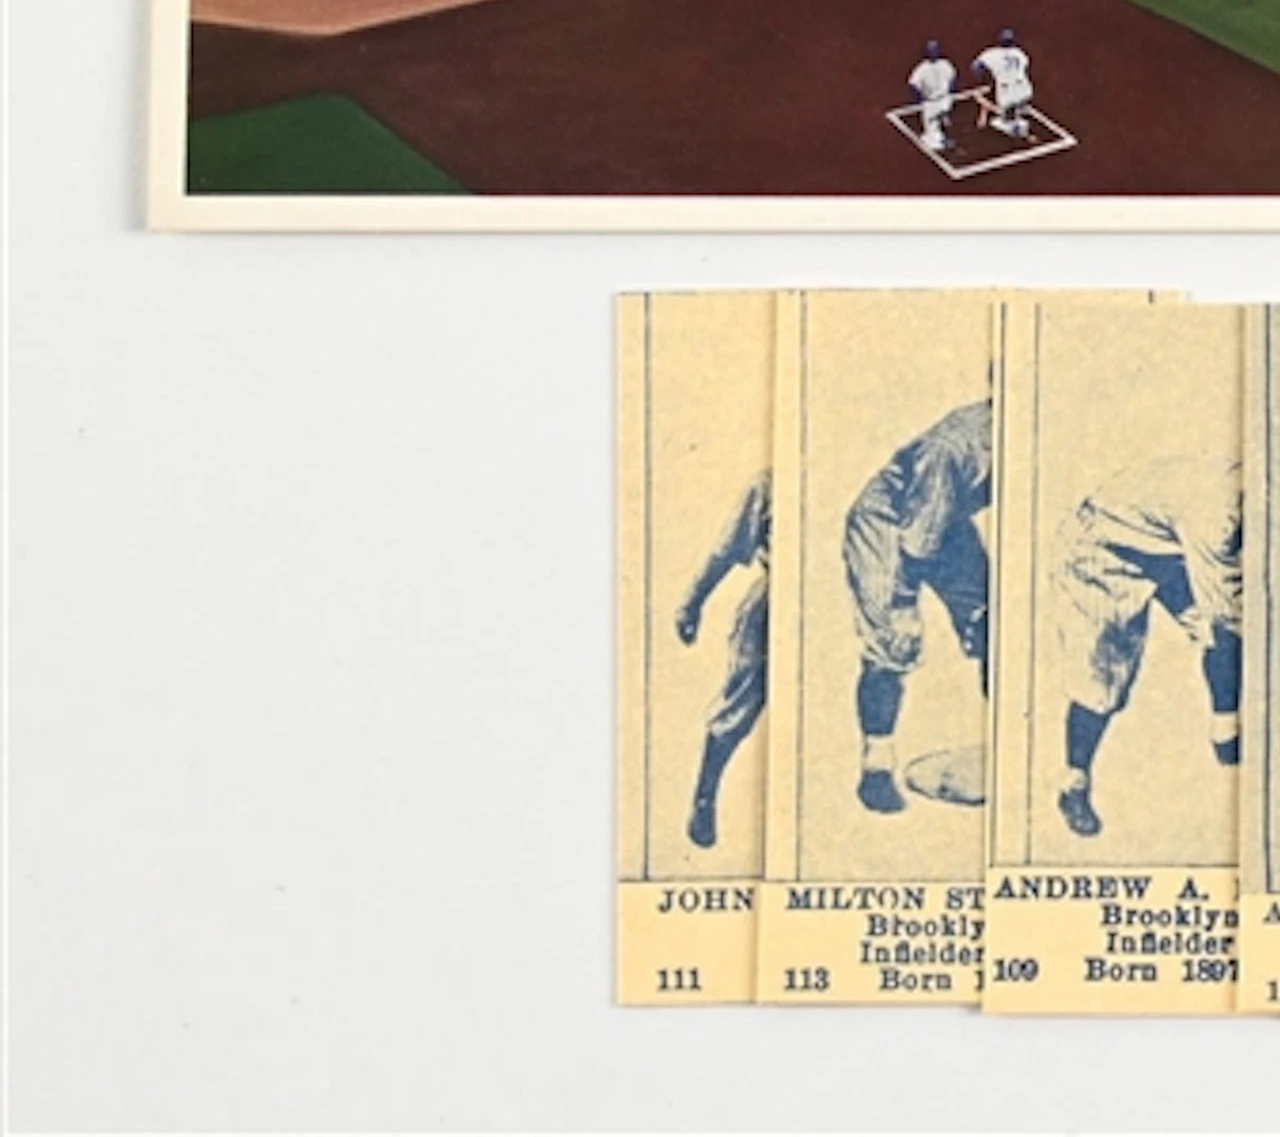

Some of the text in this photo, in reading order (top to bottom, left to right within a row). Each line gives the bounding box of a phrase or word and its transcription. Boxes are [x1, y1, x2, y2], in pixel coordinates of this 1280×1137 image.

[657, 886, 756, 914] JOHN
[785, 886, 985, 913] MILTON ST
[992, 875, 1153, 901] ANDREW
[1176, 876, 1211, 902] A.
[862, 913, 986, 945] Brookly
[1100, 900, 1241, 936] Brooklyn
[859, 937, 985, 967] Infielder
[1105, 928, 1237, 956] Infielder
[657, 967, 702, 992] 111
[784, 966, 831, 993] 113
[878, 966, 953, 993] Born
[993, 956, 1240, 985] 109 Born 1897
